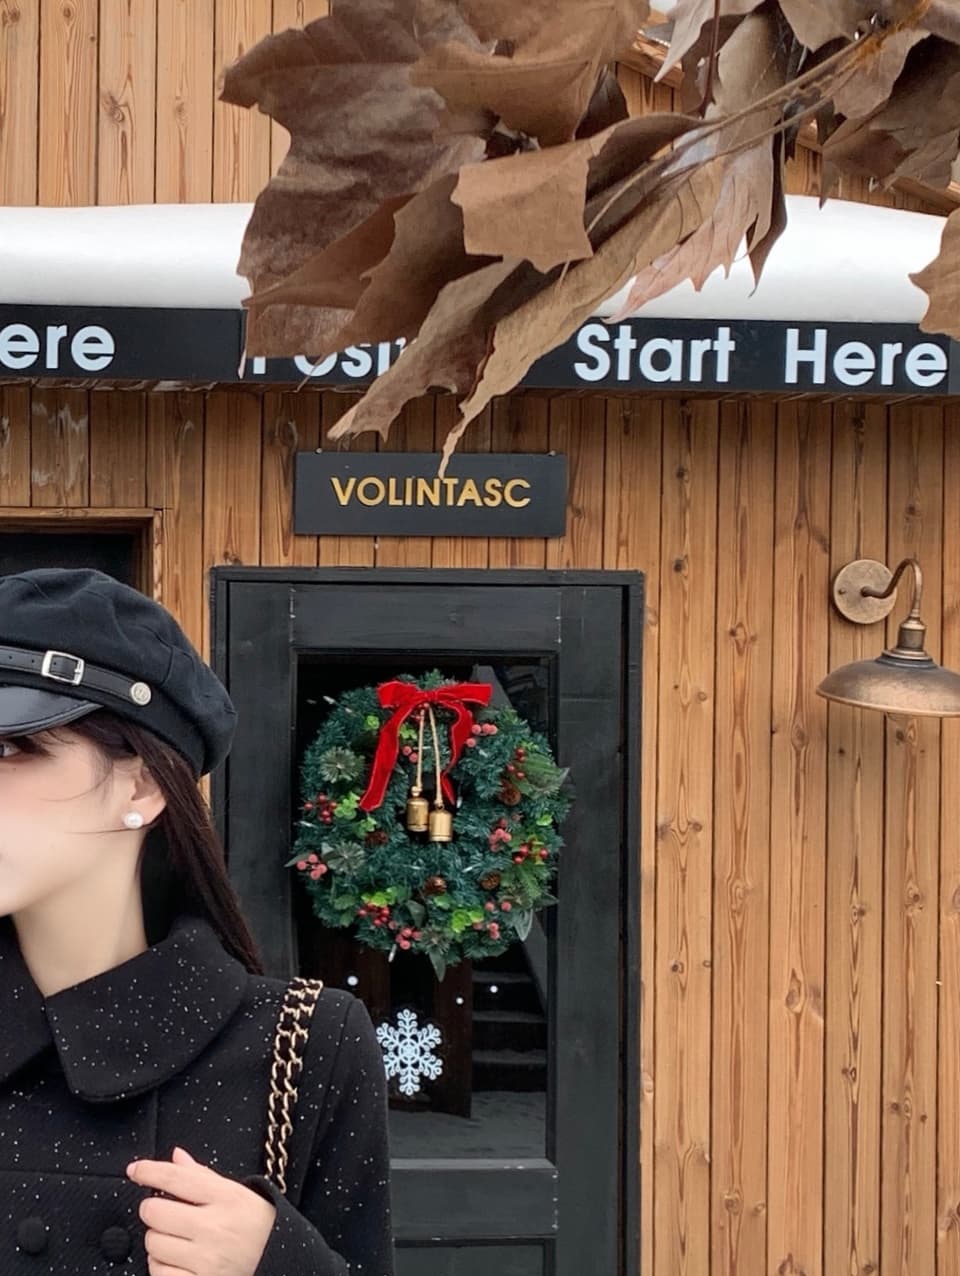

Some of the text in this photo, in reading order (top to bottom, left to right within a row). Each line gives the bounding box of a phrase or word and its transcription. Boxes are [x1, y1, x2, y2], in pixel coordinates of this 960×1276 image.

[574, 324, 948, 388] Start Here
[331, 476, 531, 508] VOLINTASC
